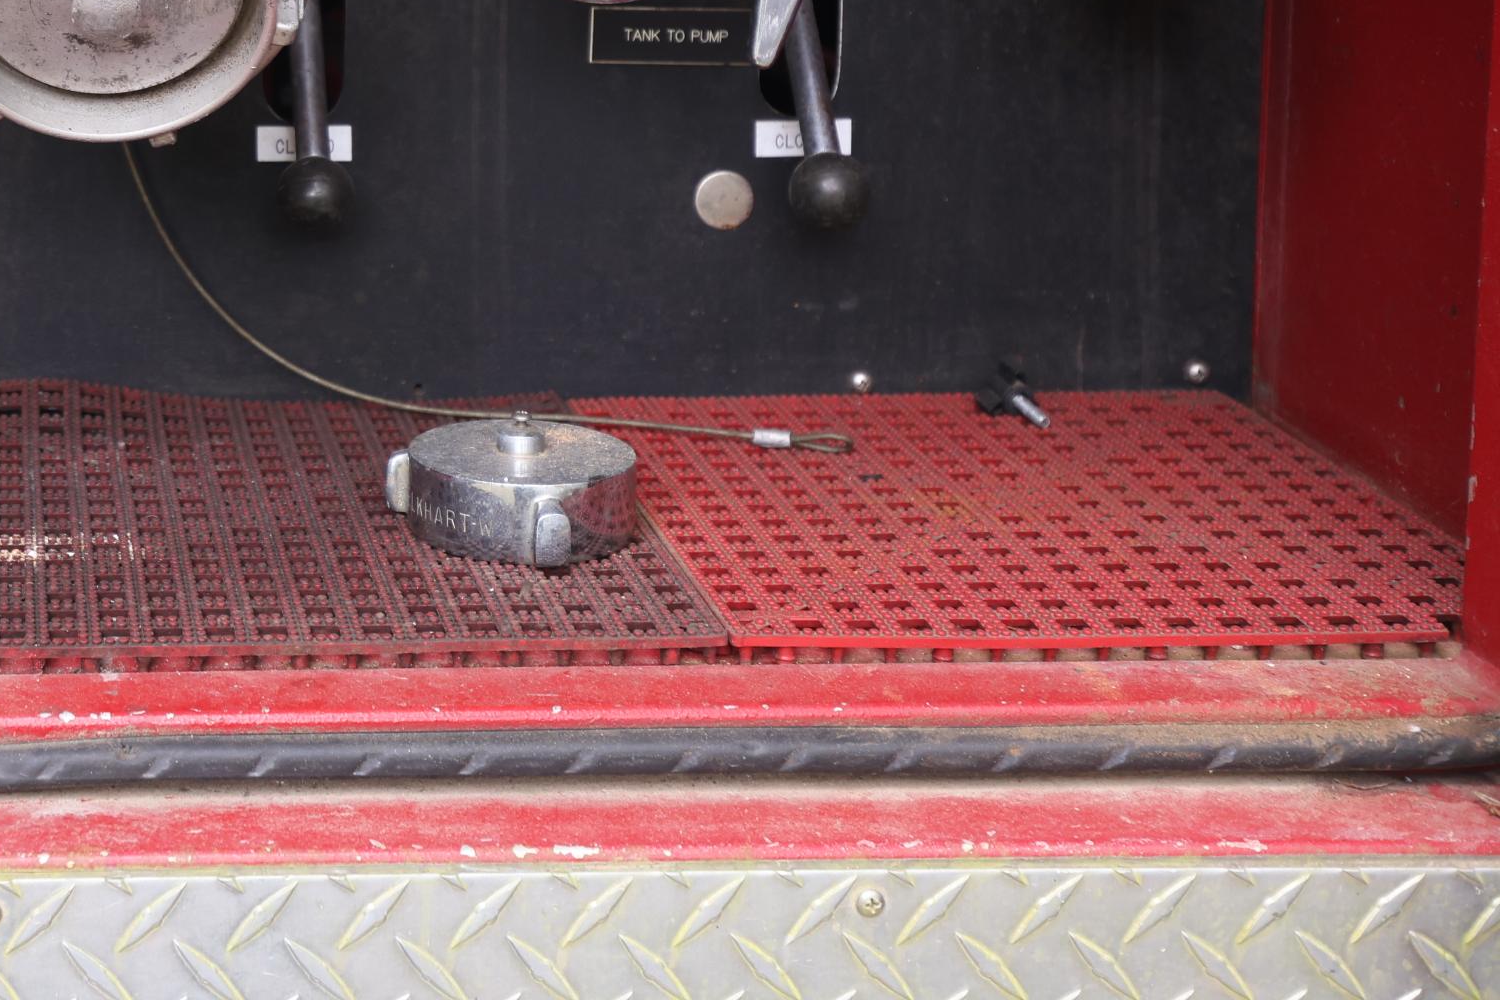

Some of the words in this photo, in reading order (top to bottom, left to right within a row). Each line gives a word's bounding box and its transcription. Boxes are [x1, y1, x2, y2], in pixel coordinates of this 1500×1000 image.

[624, 28, 661, 42] TANK
[667, 29, 685, 43] TO
[691, 30, 729, 43] PUMP
